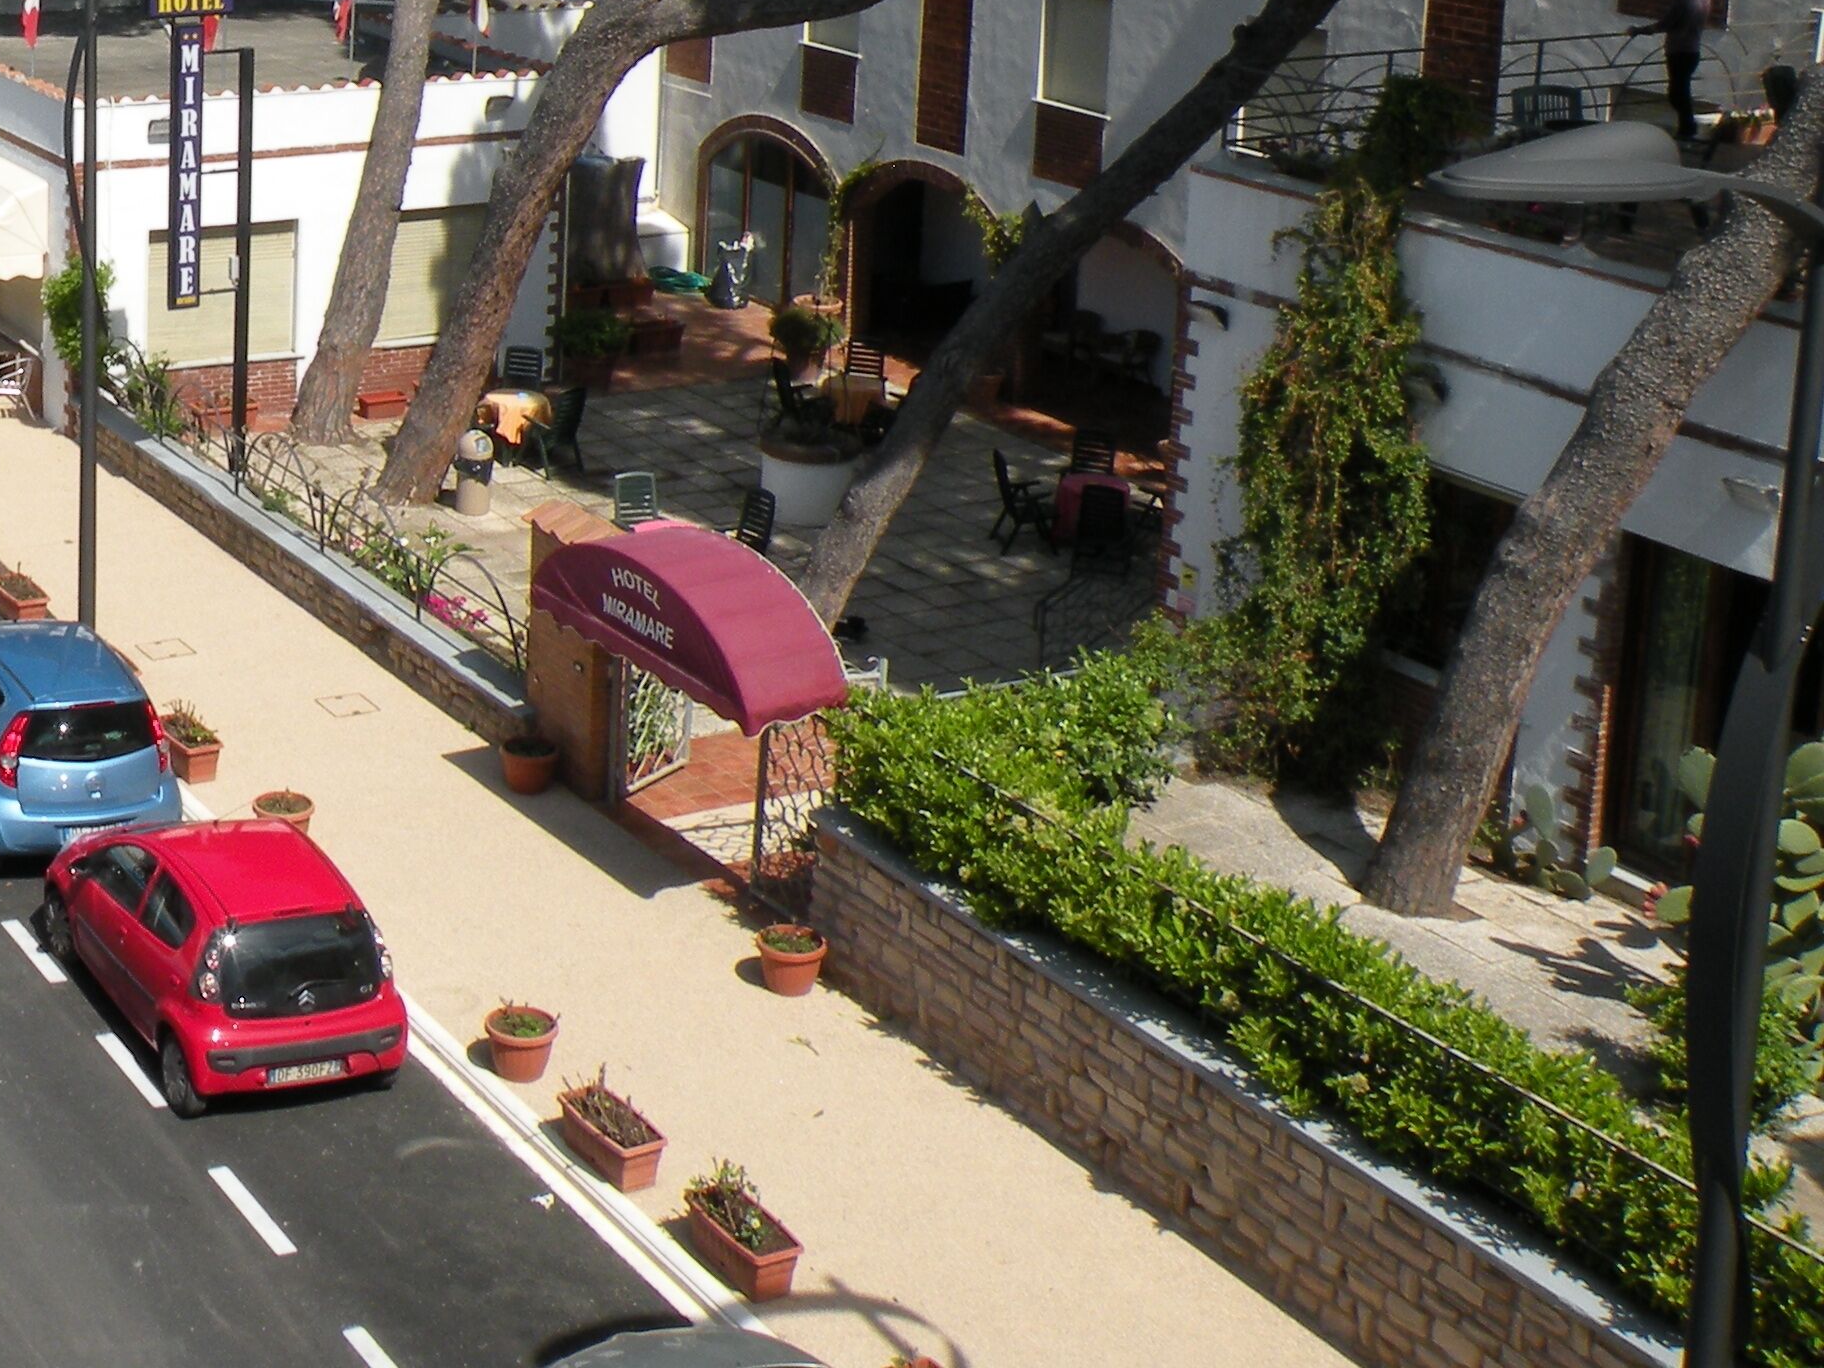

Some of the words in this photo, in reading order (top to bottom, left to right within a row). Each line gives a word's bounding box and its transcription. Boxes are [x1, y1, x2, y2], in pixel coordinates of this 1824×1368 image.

[178, 44, 200, 296] MIRAMARE
[611, 567, 661, 610] HOTEL
[602, 593, 674, 649] MIRAMARE
